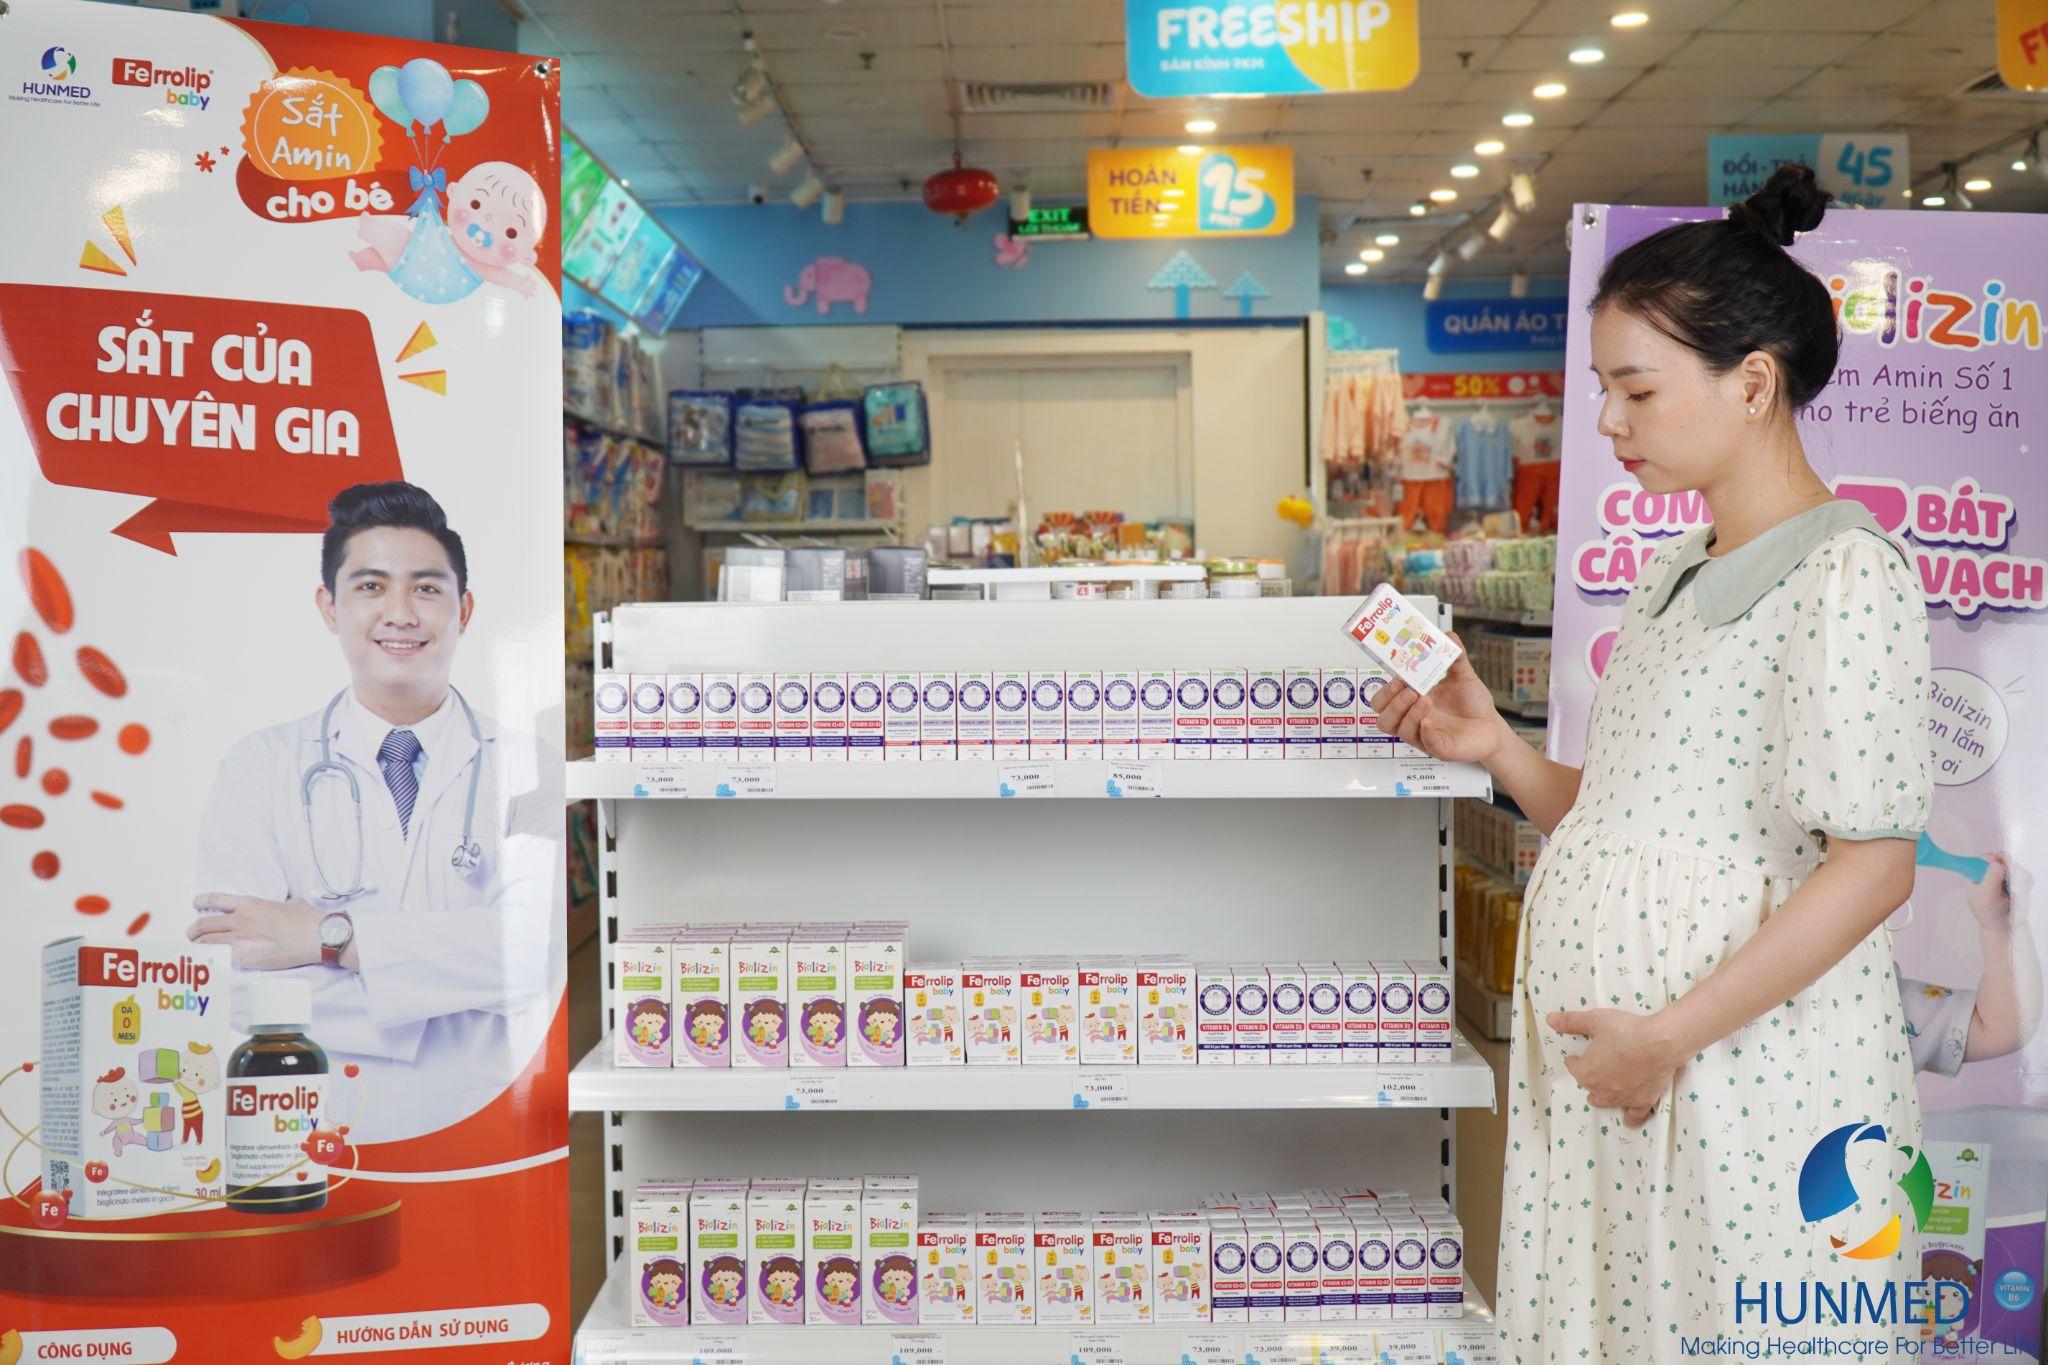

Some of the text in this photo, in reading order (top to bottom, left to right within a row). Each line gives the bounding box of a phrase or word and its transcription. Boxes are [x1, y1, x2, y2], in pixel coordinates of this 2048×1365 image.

[1157, 1, 1391, 49] FREESHIP
[124, 62, 210, 93] Ferrolip
[23, 82, 91, 98] HUNMED
[166, 89, 210, 110] baby
[281, 93, 343, 136] Sắt
[271, 136, 351, 170] Amin
[1836, 142, 1893, 187] 45
[1109, 164, 1177, 187] HOÀN
[1203, 162, 1267, 216] 15
[266, 178, 394, 218] cho bé
[1829, 271, 2041, 347] iolizin
[1516, 309, 1548, 331] ÁO
[97, 309, 312, 386] SẮT CỦA
[1872, 361, 2012, 390] Amin Số 1
[1454, 374, 1500, 397] 50%
[1845, 397, 1890, 423] trẻ
[1902, 395, 1978, 433] biếng
[1988, 402, 2020, 428] ăn
[46, 390, 359, 457] CHUYÊN GIA
[1916, 484, 2007, 540] BÁT
[1915, 554, 2043, 607] VẠCH
[1358, 597, 1393, 635] Ferrolip
[1929, 681, 1992, 730] Biolizin
[1952, 727, 1985, 758] lắm
[1941, 759, 1962, 775] ơi
[1113, 772, 1142, 780] 85,000
[103, 952, 209, 992] Ferrolip
[622, 961, 663, 973] Biolizin
[680, 962, 720, 974] Biolizin
[738, 961, 778, 973] Biolizin
[797, 961, 837, 973] Biolizin
[854, 960, 894, 973] Biolizin
[911, 976, 954, 988] Ferrolip
[969, 976, 1012, 988] Ferrolip
[1027, 975, 1070, 988] Ferrolip
[1085, 974, 1128, 987] Ferrolip
[1143, 974, 1187, 987] Ferrolip
[932, 988, 954, 996] baby
[990, 987, 1012, 996] baby
[1048, 987, 1070, 996] baby
[1107, 985, 1128, 994] baby
[1165, 986, 1187, 995] baby
[158, 988, 209, 1016] baby
[121, 1006, 133, 1014] DA
[123, 1017, 131, 1029] 0
[117, 1032, 136, 1040] MESI
[232, 1086, 318, 1115] Ferrolip
[274, 1114, 318, 1133] baby
[317, 1139, 334, 1153] Fe
[92, 1167, 103, 1176] Fe
[194, 1186, 221, 1199] 30 ml
[41, 1203, 59, 1217] Fe
[638, 1221, 678, 1233] Biolizin
[698, 1218, 738, 1231] Biolizin
[755, 1219, 795, 1231] Biolizin
[813, 1219, 852, 1232] Biolizin
[869, 1217, 909, 1230] Biolizin
[924, 1234, 967, 1246] Ferrolip
[982, 1234, 1025, 1246] Ferrolip
[1042, 1235, 1084, 1247] Ferrolip
[1100, 1234, 1143, 1246] Ferrolip
[1158, 1233, 1201, 1245] Ferrolip
[945, 1246, 967, 1255] baby
[1004, 1246, 1025, 1255] baby
[1063, 1246, 1084, 1255] baby
[1122, 1246, 1143, 1255] baby
[1180, 1245, 1201, 1254] baby
[1999, 1284, 2030, 1293] VITAMIN
[2008, 1293, 2019, 1302] B6
[337, 1319, 509, 1345] HƯỚNG DẪN SỬ DỤNG
[37, 1340, 133, 1362] CÔNG DỤNG
